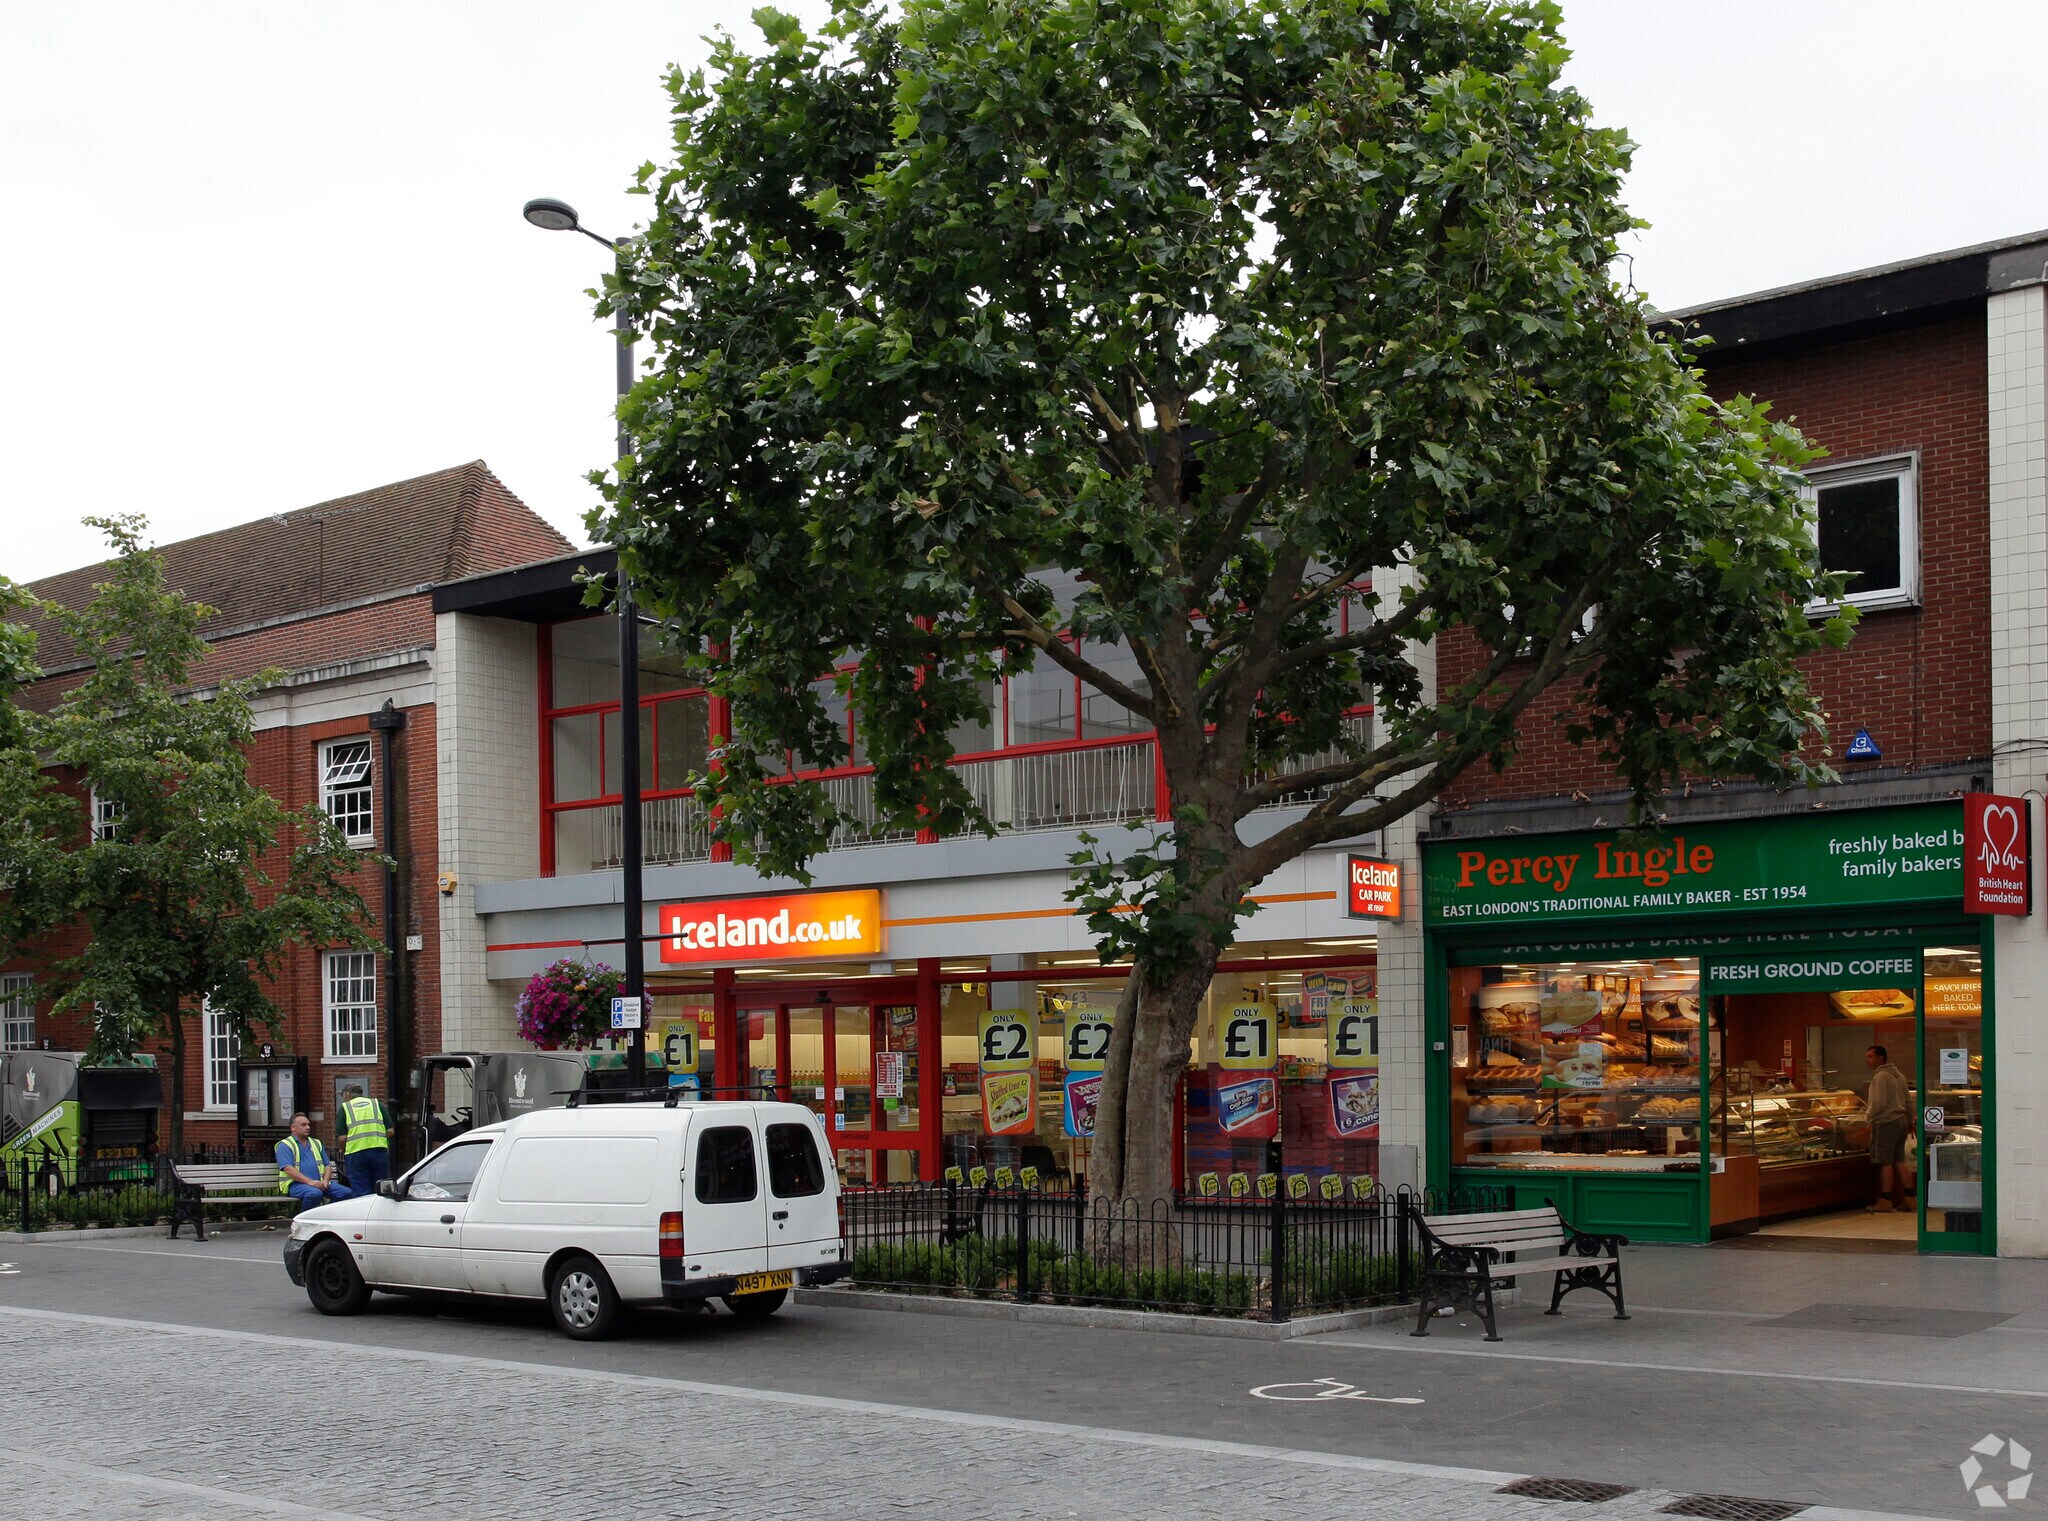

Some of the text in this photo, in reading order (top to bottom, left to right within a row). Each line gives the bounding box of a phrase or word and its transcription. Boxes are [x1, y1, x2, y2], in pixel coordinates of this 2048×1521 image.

[1828, 838, 1888, 856] freshly
[1892, 830, 1947, 850] baked
[1456, 837, 1714, 892] Percy Ingle
[1842, 855, 1962, 879] family bakers
[1352, 863, 1398, 888] Iceland
[1979, 876, 2023, 890] British Heart
[1358, 888, 1392, 902] CAR PARK
[1442, 904, 1473, 917] EAST
[1475, 900, 1540, 916] LONDON'S
[1543, 896, 1630, 912] TRADITIONAL
[1633, 892, 1683, 908] FAMILY
[1686, 889, 1731, 904] BAKER
[1743, 887, 1768, 901] EST
[1772, 885, 1807, 900] 1954
[1979, 890, 2023, 904] Foundation
[1367, 903, 1384, 912] at rear
[672, 908, 862, 950] Iceland.co.uk
[1710, 958, 1913, 980] FRESH GROUND COFFEE
[1307, 977, 1324, 989] WIN
[1327, 981, 1346, 992] SAVE
[614, 1000, 621, 1012] P
[1943, 993, 1974, 1002] BAKED
[1233, 1008, 1259, 1017] ONLY
[1344, 1004, 1371, 1014] ONLY
[1932, 1003, 1956, 1011] HERE
[992, 1014, 1015, 1023] ONLY
[1080, 1013, 1104, 1021] ONLY
[983, 1023, 1030, 1062] £2
[1068, 1023, 1113, 1060] £2
[1224, 1018, 1268, 1058] £1
[1335, 1015, 1378, 1056] £1
[663, 1033, 692, 1066] £1
[11, 1108, 62, 1150] GREEN MACHINES
[1345, 1117, 1352, 1125] 6
[735, 1271, 794, 1292] N497 XNN
